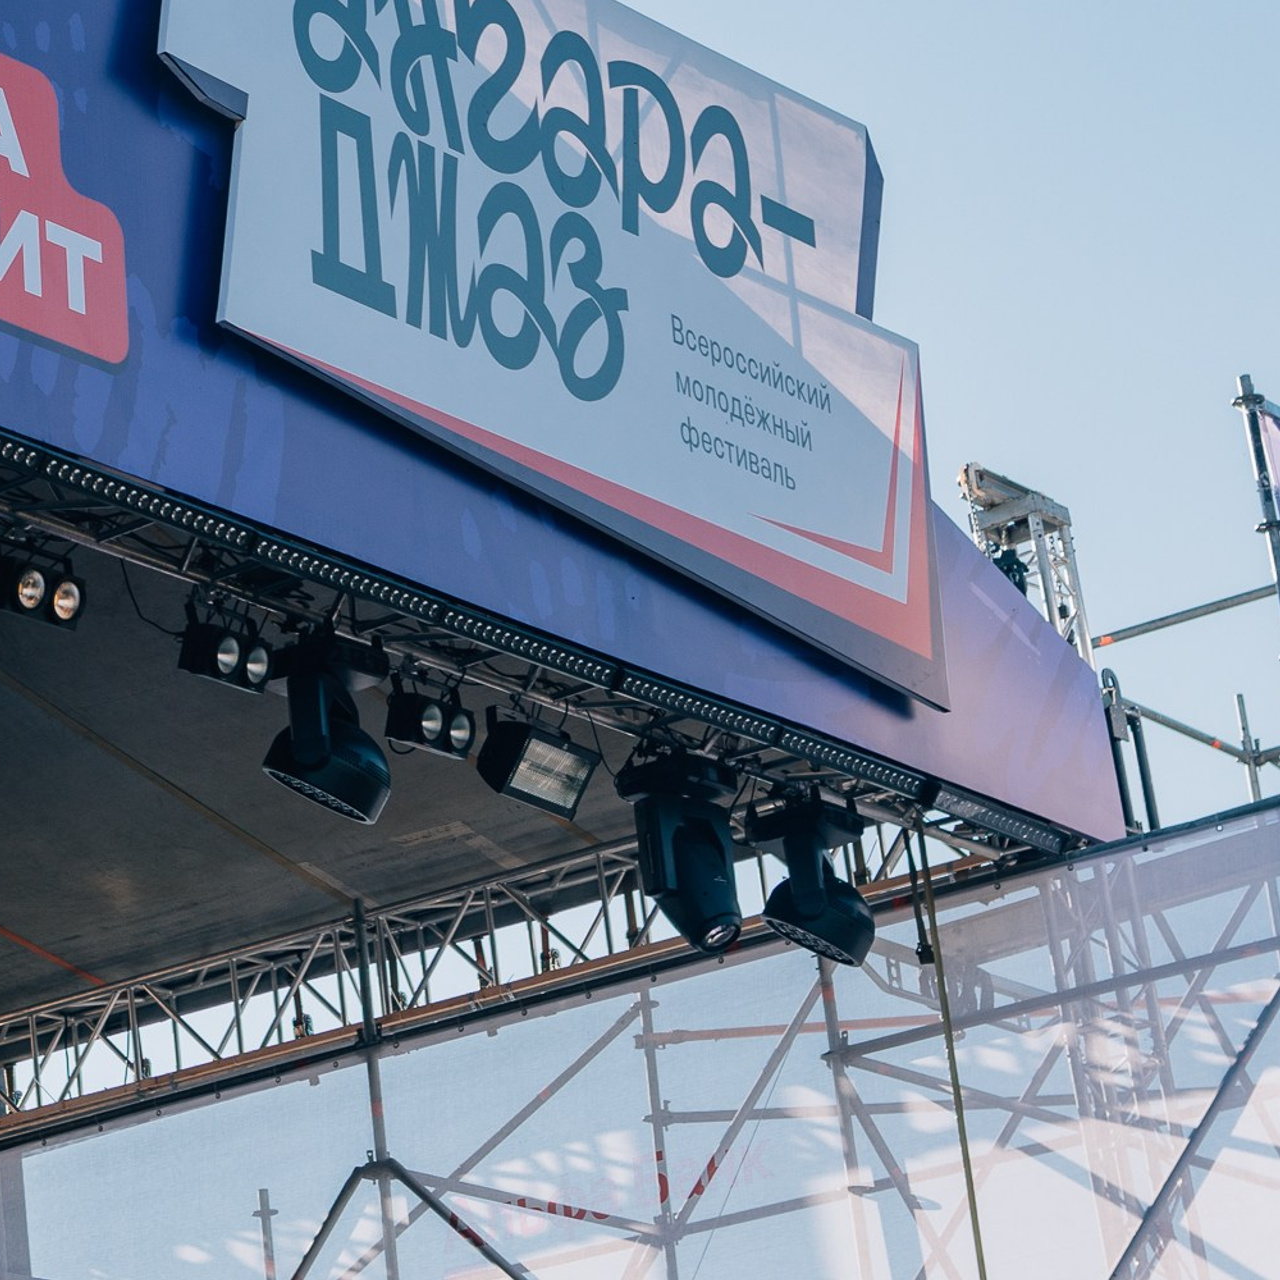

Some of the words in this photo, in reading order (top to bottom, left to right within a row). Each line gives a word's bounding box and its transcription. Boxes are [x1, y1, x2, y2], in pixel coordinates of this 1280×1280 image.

[671, 313, 831, 414] Всероссийский
[676, 371, 812, 451] молодёжный
[680, 416, 796, 490] фестиваль
